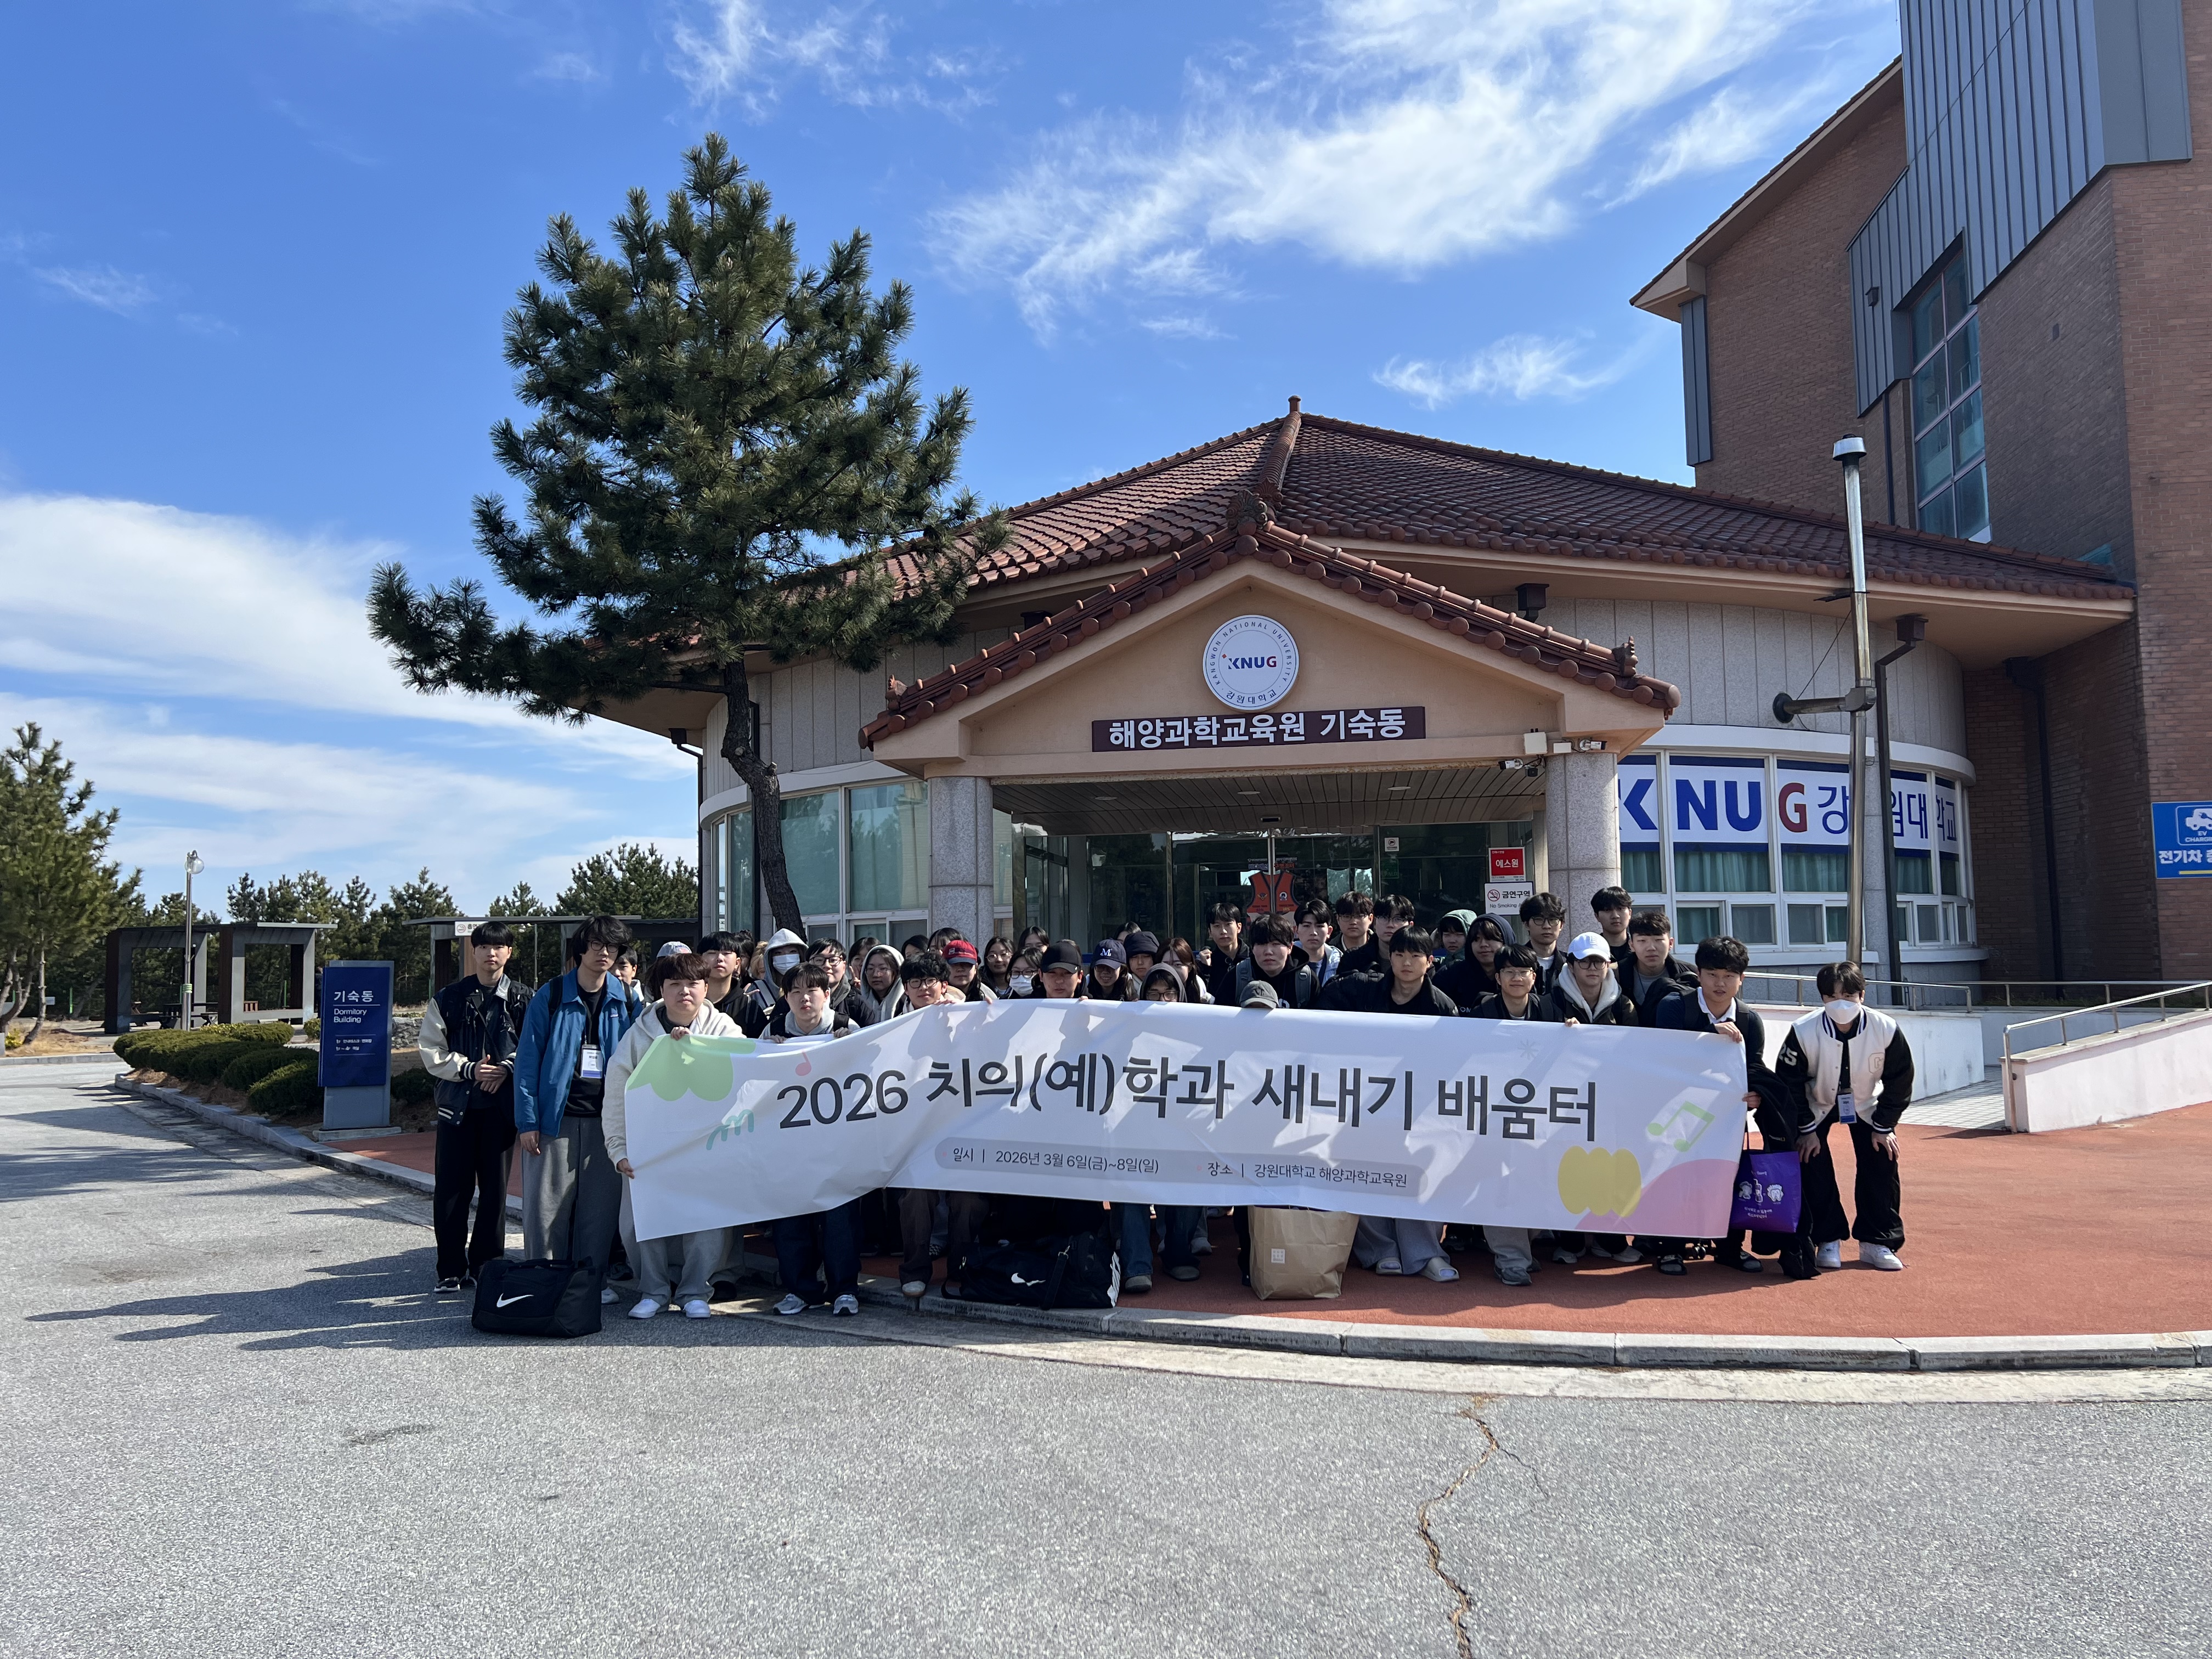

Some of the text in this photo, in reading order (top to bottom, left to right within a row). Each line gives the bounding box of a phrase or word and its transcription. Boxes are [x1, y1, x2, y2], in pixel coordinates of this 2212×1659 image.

[1210, 622, 1292, 685] KANGWON NATIONAL UNIVERSITY
[1228, 656, 1277, 670] KNUG
[1226, 689, 1277, 704] 강원대학교
[1109, 708, 1406, 749] 해양과학교육원 기숙동
[1618, 778, 1808, 833] KNUG
[1496, 859, 1519, 868] 에스원
[2158, 849, 2203, 864] 전기차
[1502, 890, 1530, 899] 금연구역
[334, 990, 374, 1002] 기숙동
[1779, 1043, 1798, 1066] 25
[777, 1053, 1596, 1142] 2026 치의(예)학과 새내기 배움터
[953, 1147, 1159, 1174] 일시 2026년 3월 6일(금)~8일(일)
[1207, 1161, 1407, 1188] 장소 강원대학교 해양과학교육원
